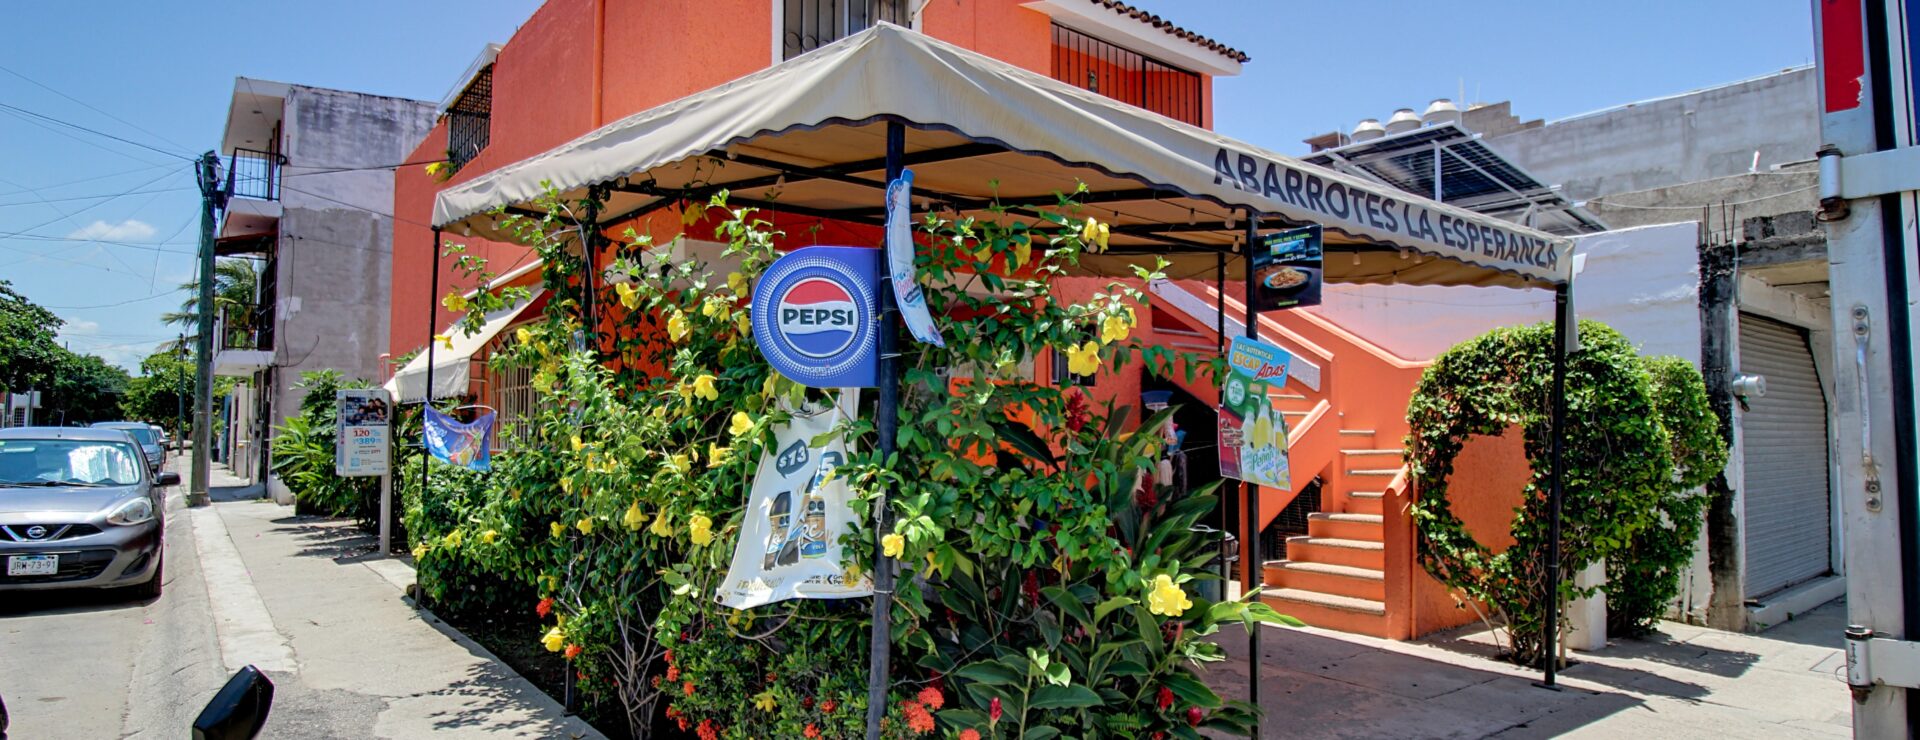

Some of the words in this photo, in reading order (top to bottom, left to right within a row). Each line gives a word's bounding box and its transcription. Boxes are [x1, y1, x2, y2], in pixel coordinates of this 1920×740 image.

[1214, 147, 1399, 233] ABARROTES
[1403, 203, 1438, 243] LA
[1439, 214, 1558, 271] ESPERANZA
[783, 308, 854, 326] PEPSI
[353, 429, 370, 437] 120
[779, 445, 807, 468] $13
[801, 523, 825, 542] RC
